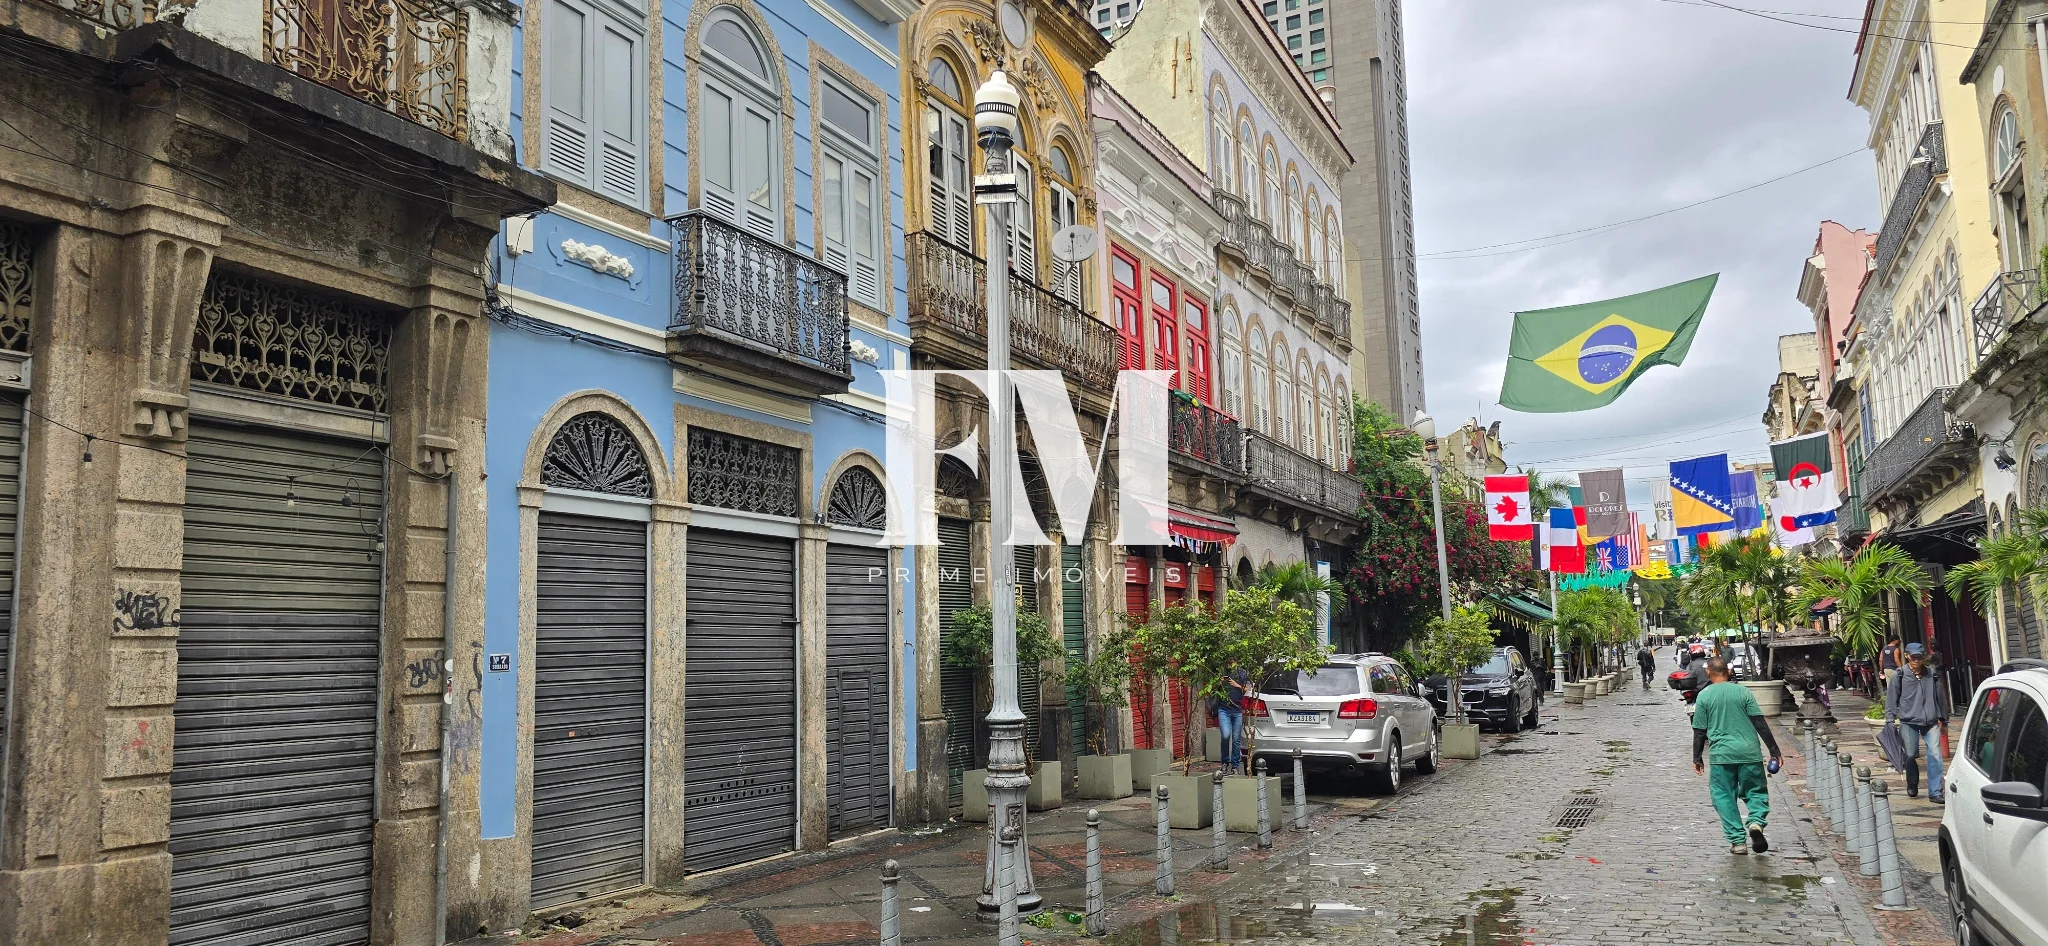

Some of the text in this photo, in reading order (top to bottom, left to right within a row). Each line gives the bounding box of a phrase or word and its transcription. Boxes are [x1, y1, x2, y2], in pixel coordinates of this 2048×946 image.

[1588, 504, 1624, 513] DOLORES
[1653, 500, 1672, 509] visit
[1655, 508, 1674, 523] RI
[501, 656, 507, 664] 7
